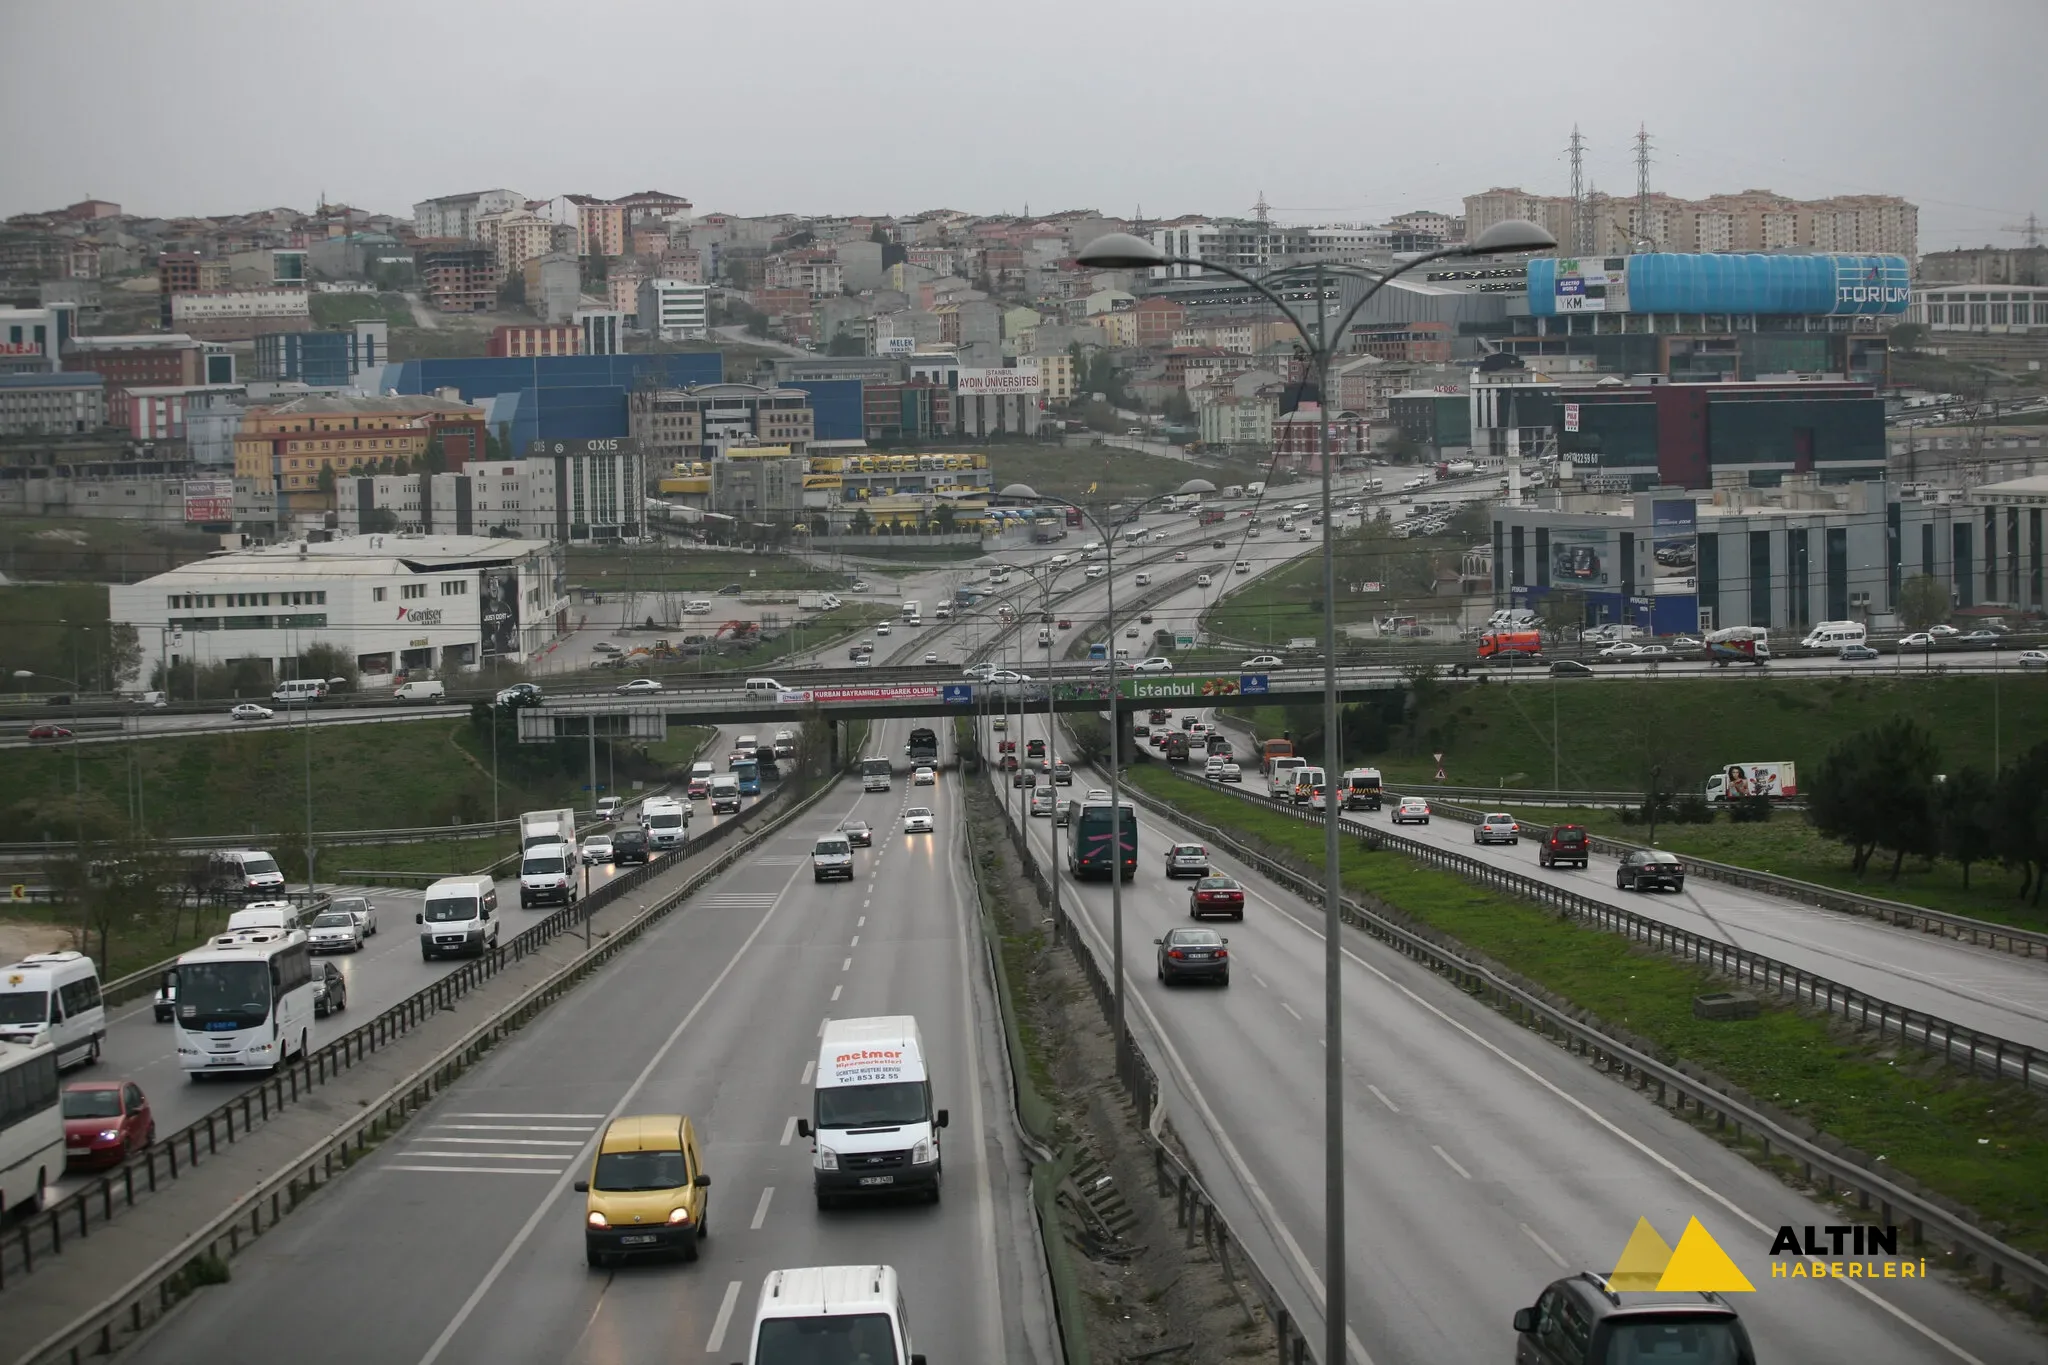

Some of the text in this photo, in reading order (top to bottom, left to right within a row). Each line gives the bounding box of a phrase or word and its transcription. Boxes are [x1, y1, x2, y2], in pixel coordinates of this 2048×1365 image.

[1839, 286, 1911, 303] TORIUM
[1560, 297, 1582, 309] YKM
[890, 339, 913, 348] MELEK
[960, 374, 1039, 388] AYDIN ÜNİVERSİTESİ
[407, 607, 443, 623] Graniser
[815, 690, 841, 698] KURBAN
[842, 689, 880, 697] BAYRAMINIZ
[1133, 680, 1195, 697] İstanbul
[836, 1050, 903, 1062] metmar
